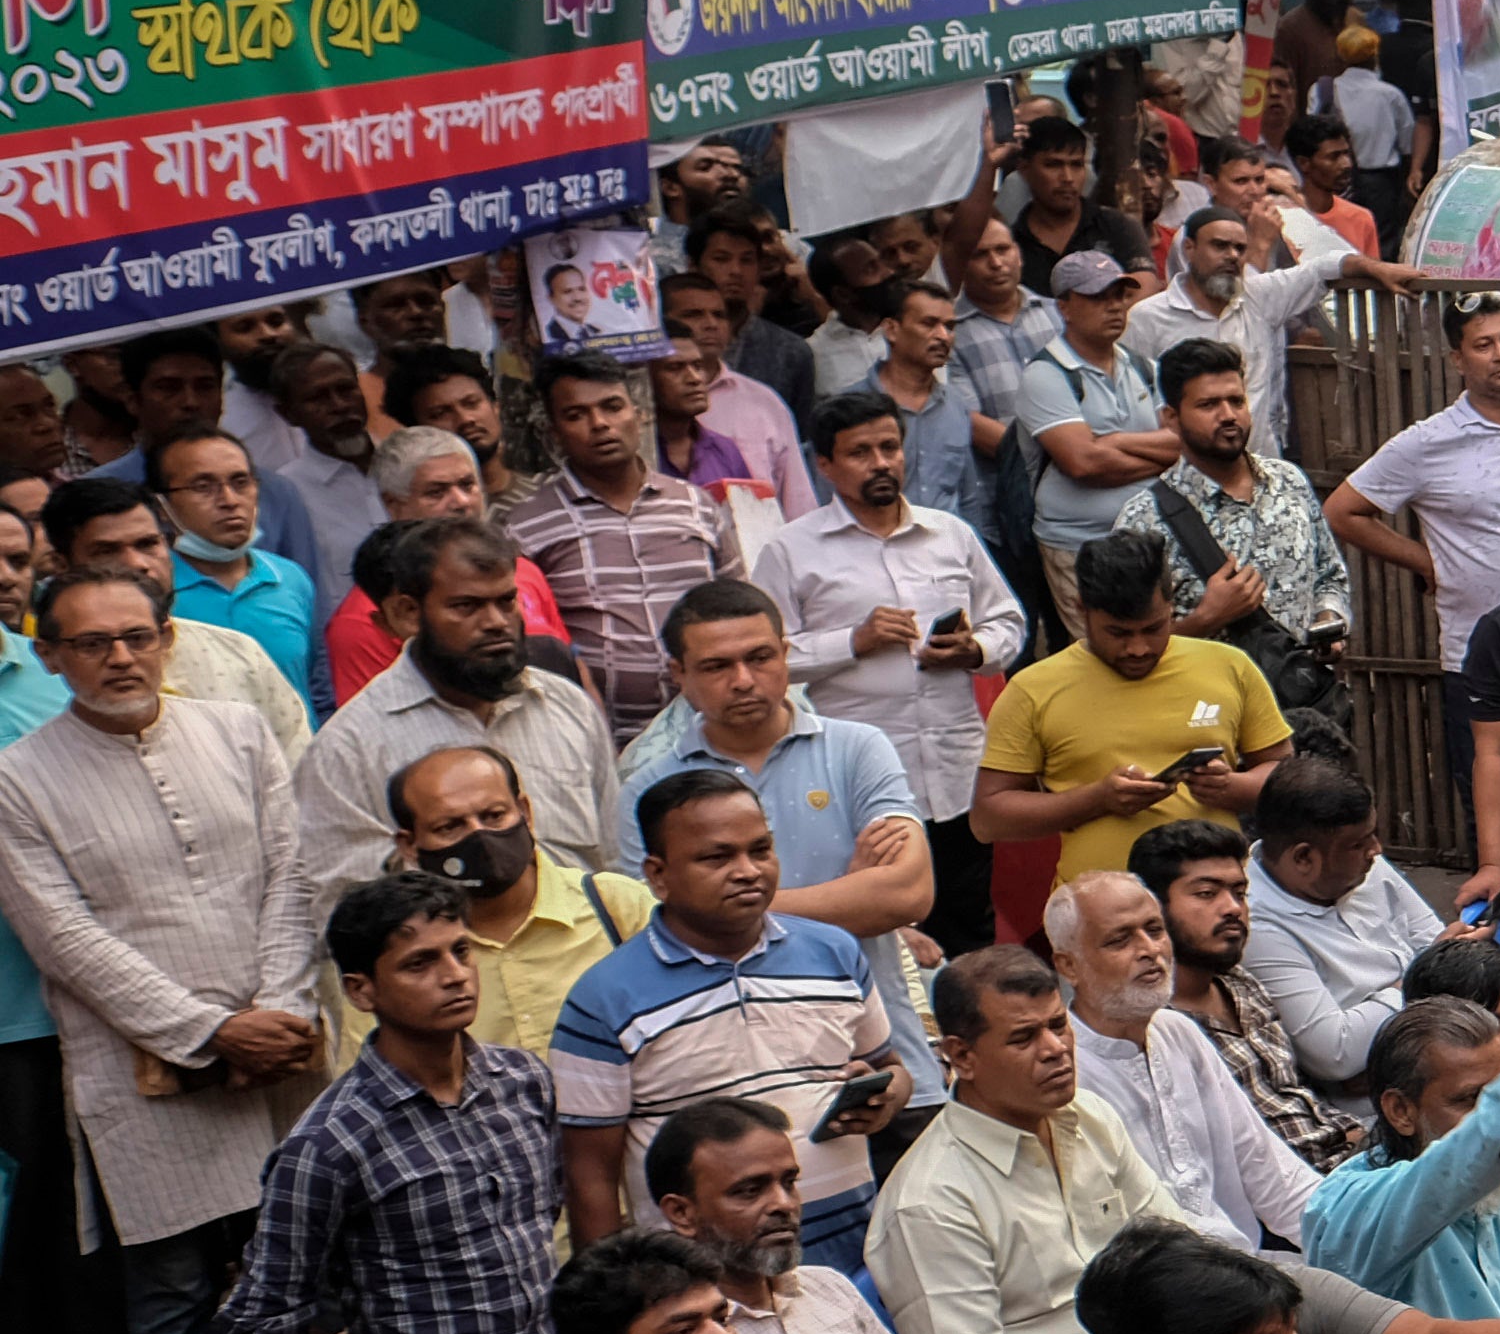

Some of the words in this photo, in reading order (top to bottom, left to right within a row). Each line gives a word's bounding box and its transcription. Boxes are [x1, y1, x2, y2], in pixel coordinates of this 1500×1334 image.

[648, 67, 738, 125] ৬৭নং
[743, 37, 823, 104] ওয়ার্ড
[826, 26, 937, 90] আওয়ামী
[941, 18, 1004, 73] লীগ,
[1006, 27, 1059, 66] ডেমরা
[1105, 12, 1141, 45] ঢাকা
[1142, 8, 1199, 40] মহানগর
[141, 117, 289, 204] মাসুম
[299, 109, 416, 172] সাধারণ
[421, 87, 545, 152] সম্পাদক
[550, 61, 640, 126] পদপ্রার্থী
[35, 247, 119, 312] ওয়ার্ড
[121, 225, 243, 298] আওয়ামী
[248, 212, 345, 285] যুবলীগ,
[348, 187, 456, 255] কদমতলী
[458, 183, 521, 235] থানা,
